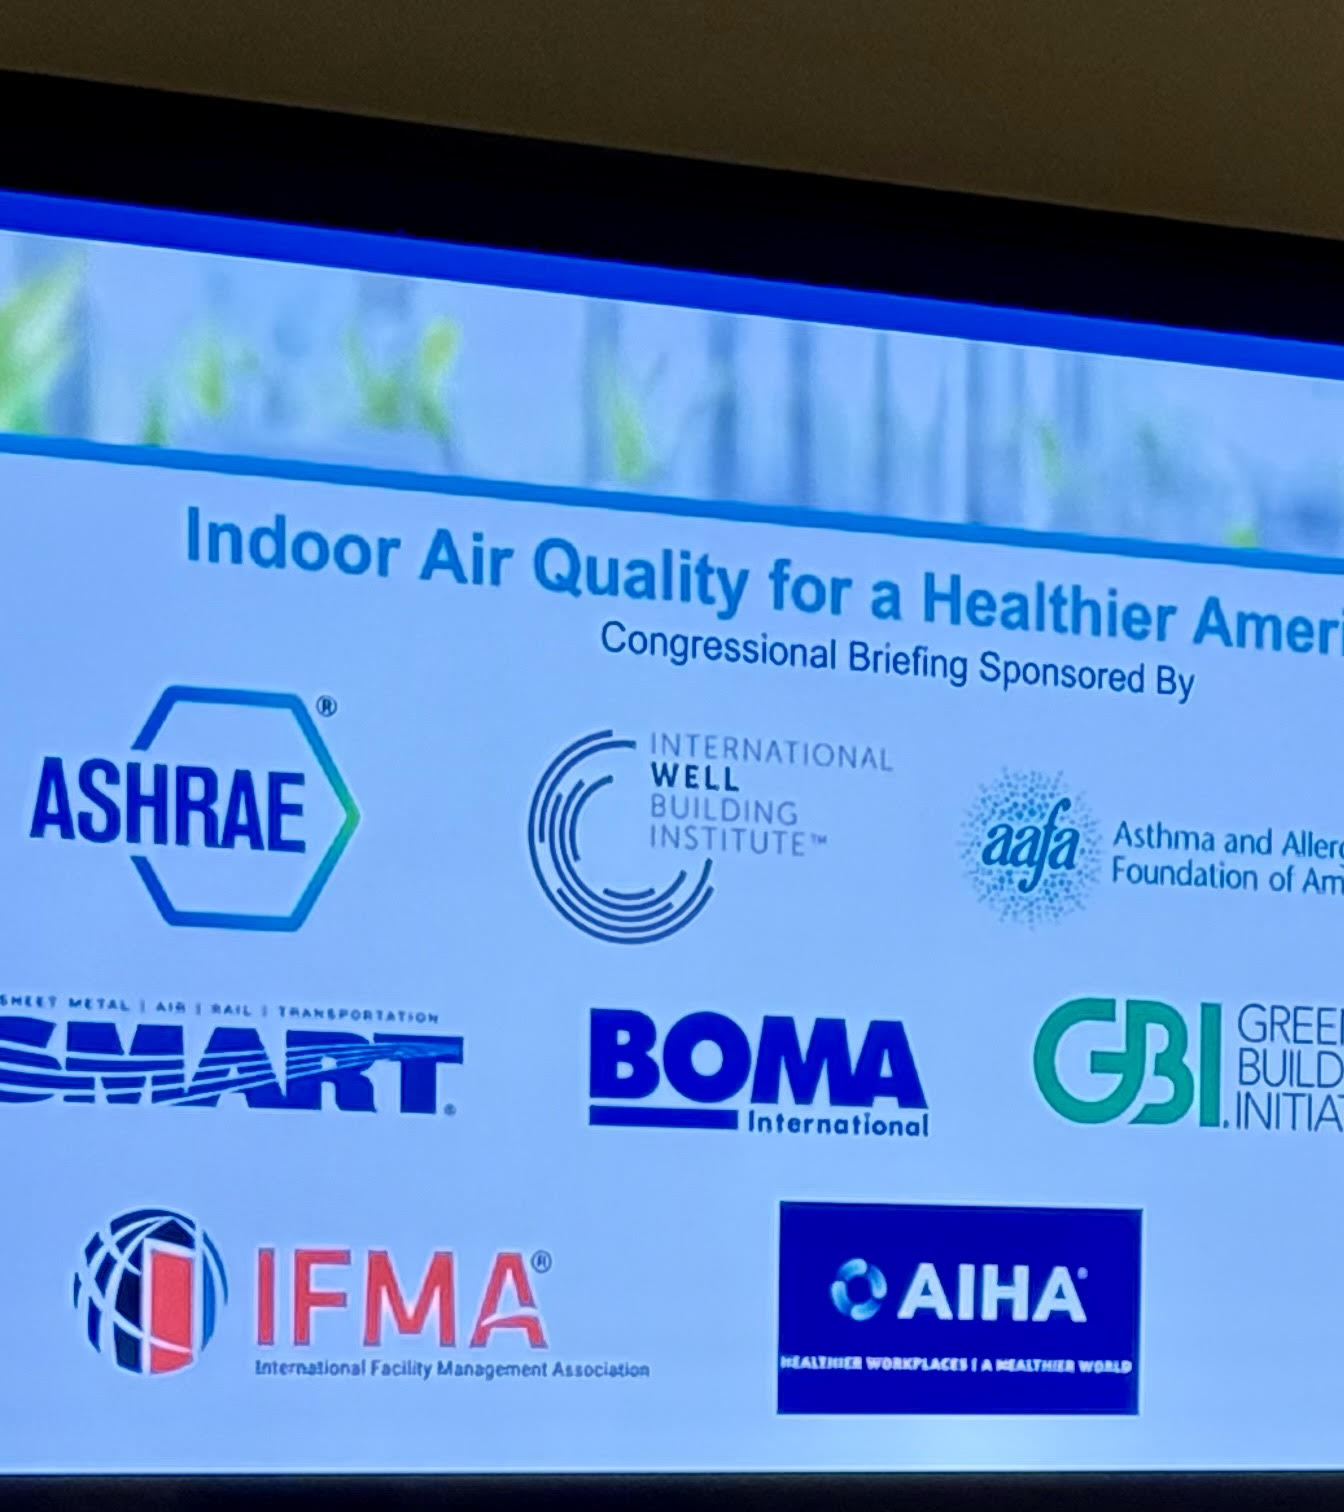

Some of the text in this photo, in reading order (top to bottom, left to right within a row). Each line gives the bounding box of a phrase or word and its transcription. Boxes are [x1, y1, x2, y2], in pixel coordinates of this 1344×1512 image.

[185, 507, 402, 577] Indoor
[419, 528, 515, 587] Air
[532, 536, 751, 620] Quality
[768, 557, 854, 615] for
[870, 580, 903, 621] a
[923, 570, 1178, 642] Healthier
[599, 618, 1196, 704] Congressional Briefing Sponsored By
[650, 731, 894, 772] INTERNATIONAL
[650, 760, 740, 792] WELL
[28, 756, 307, 854] ASHRAE
[650, 792, 799, 826] BUILDING
[980, 798, 1081, 893] aafa
[1112, 820, 1216, 853] Asthma
[1223, 828, 1272, 855] and
[1111, 855, 1259, 891] Foundation
[1269, 865, 1297, 892] of
[68, 997, 131, 1013] METAL
[156, 1002, 186, 1014] AIR
[211, 1005, 252, 1017] RAIL
[278, 1005, 440, 1025] TRANSPORTATION
[0, 1015, 464, 1115] SMART
[589, 1007, 929, 1110] BOMA
[1033, 997, 1222, 1128] GBI
[747, 1108, 930, 1138] International
[257, 1248, 547, 1348] IFMA
[897, 1262, 1087, 1324] AIHA
[256, 1359, 650, 1381] International Facility Management Association
[780, 1355, 863, 1371] HEALTHIER
[865, 1356, 968, 1373] WORKPLACES
[995, 1358, 1076, 1374] HEALTHIER
[1078, 1360, 1133, 1375] WORLD
